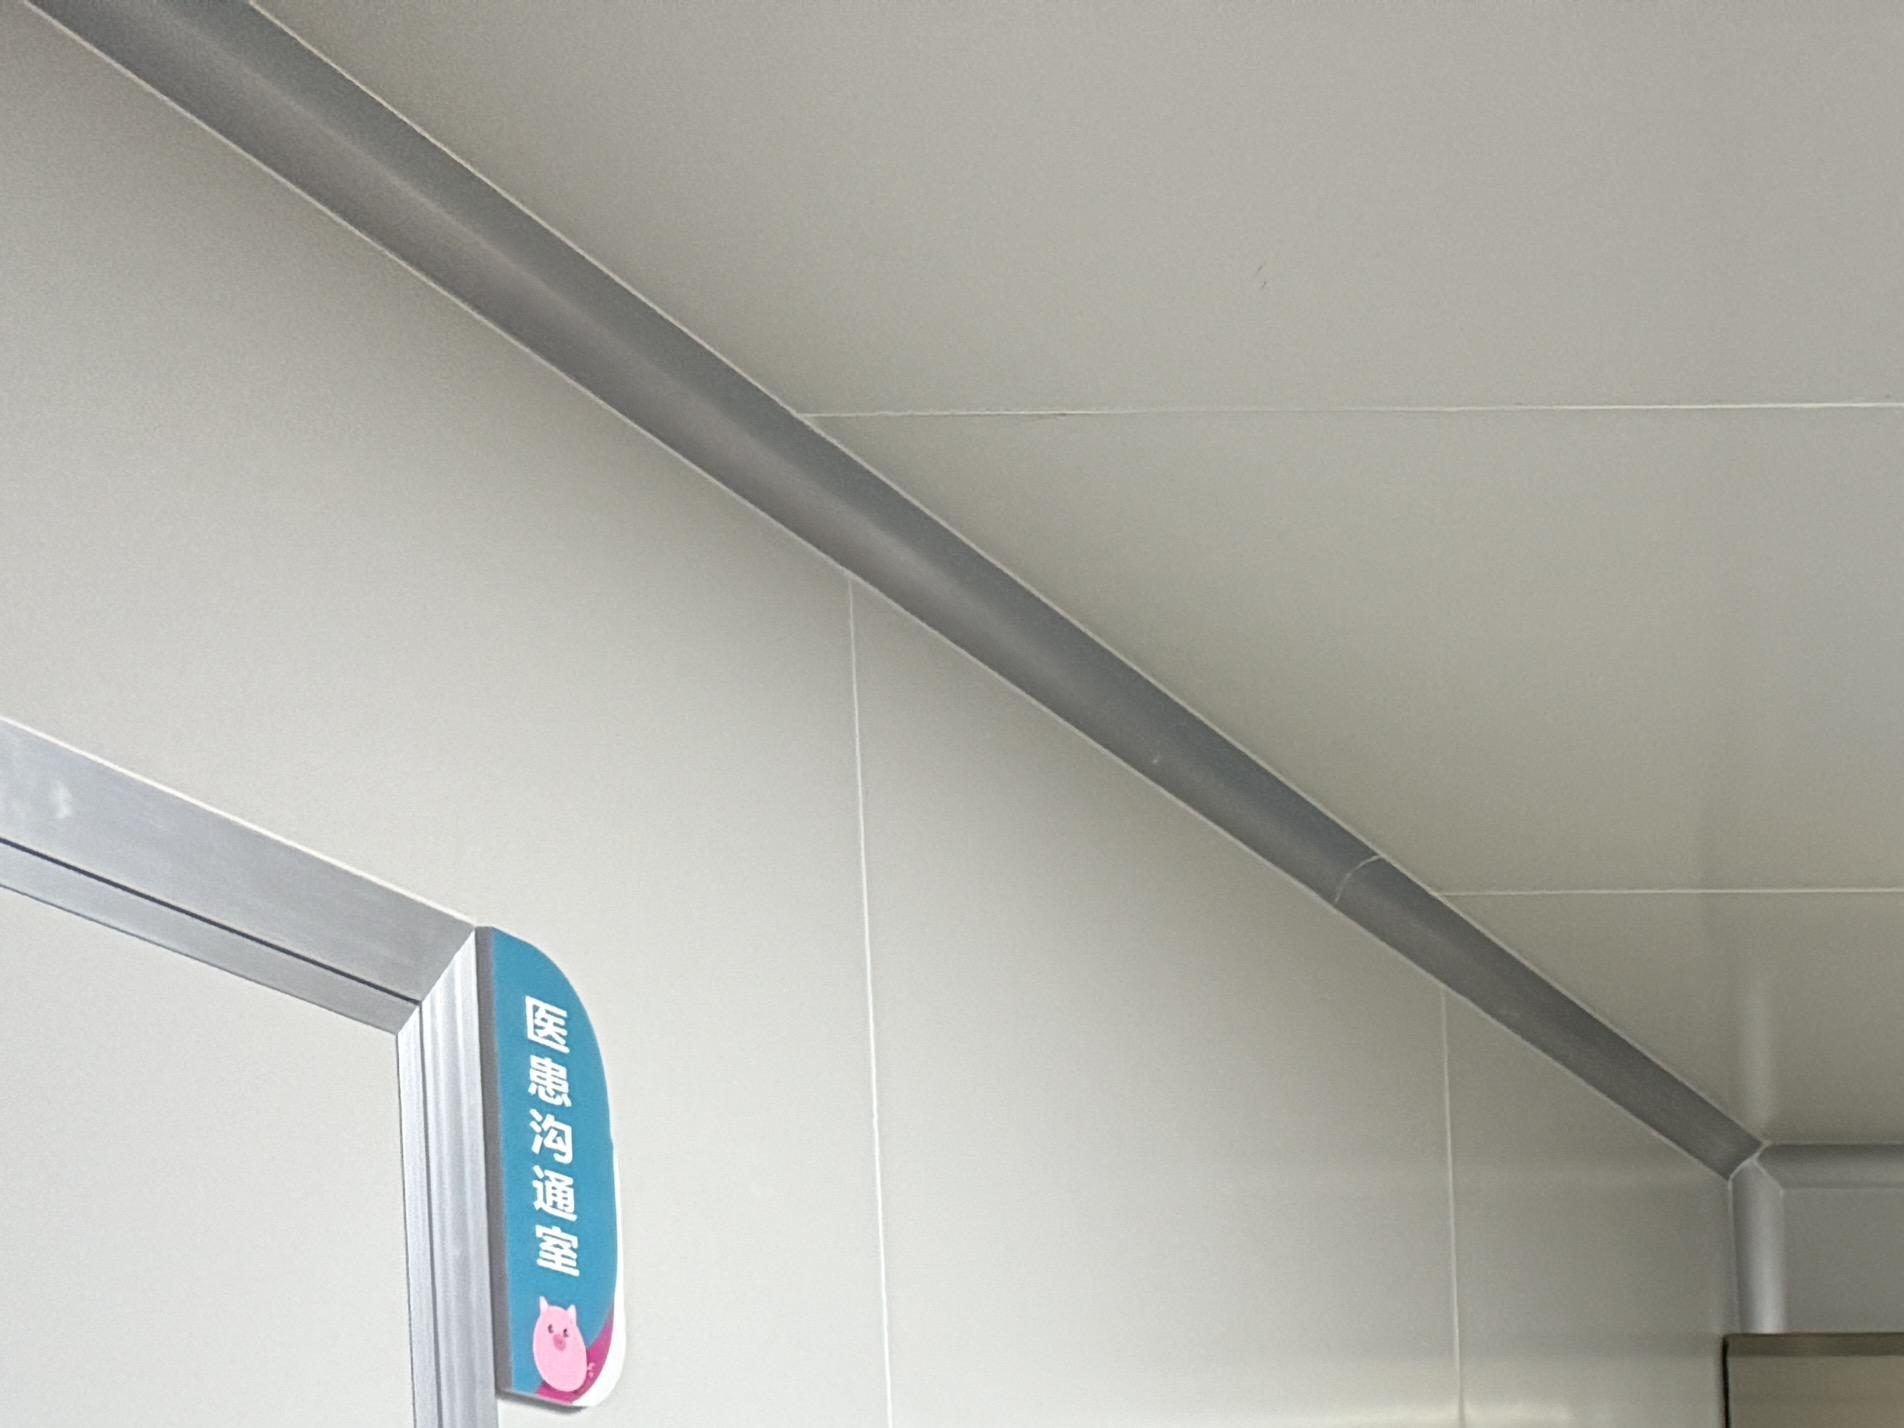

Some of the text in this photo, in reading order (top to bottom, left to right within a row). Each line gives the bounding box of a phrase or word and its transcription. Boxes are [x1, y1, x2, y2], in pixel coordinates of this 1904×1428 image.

[524, 995, 580, 1277] 医患沟通室
